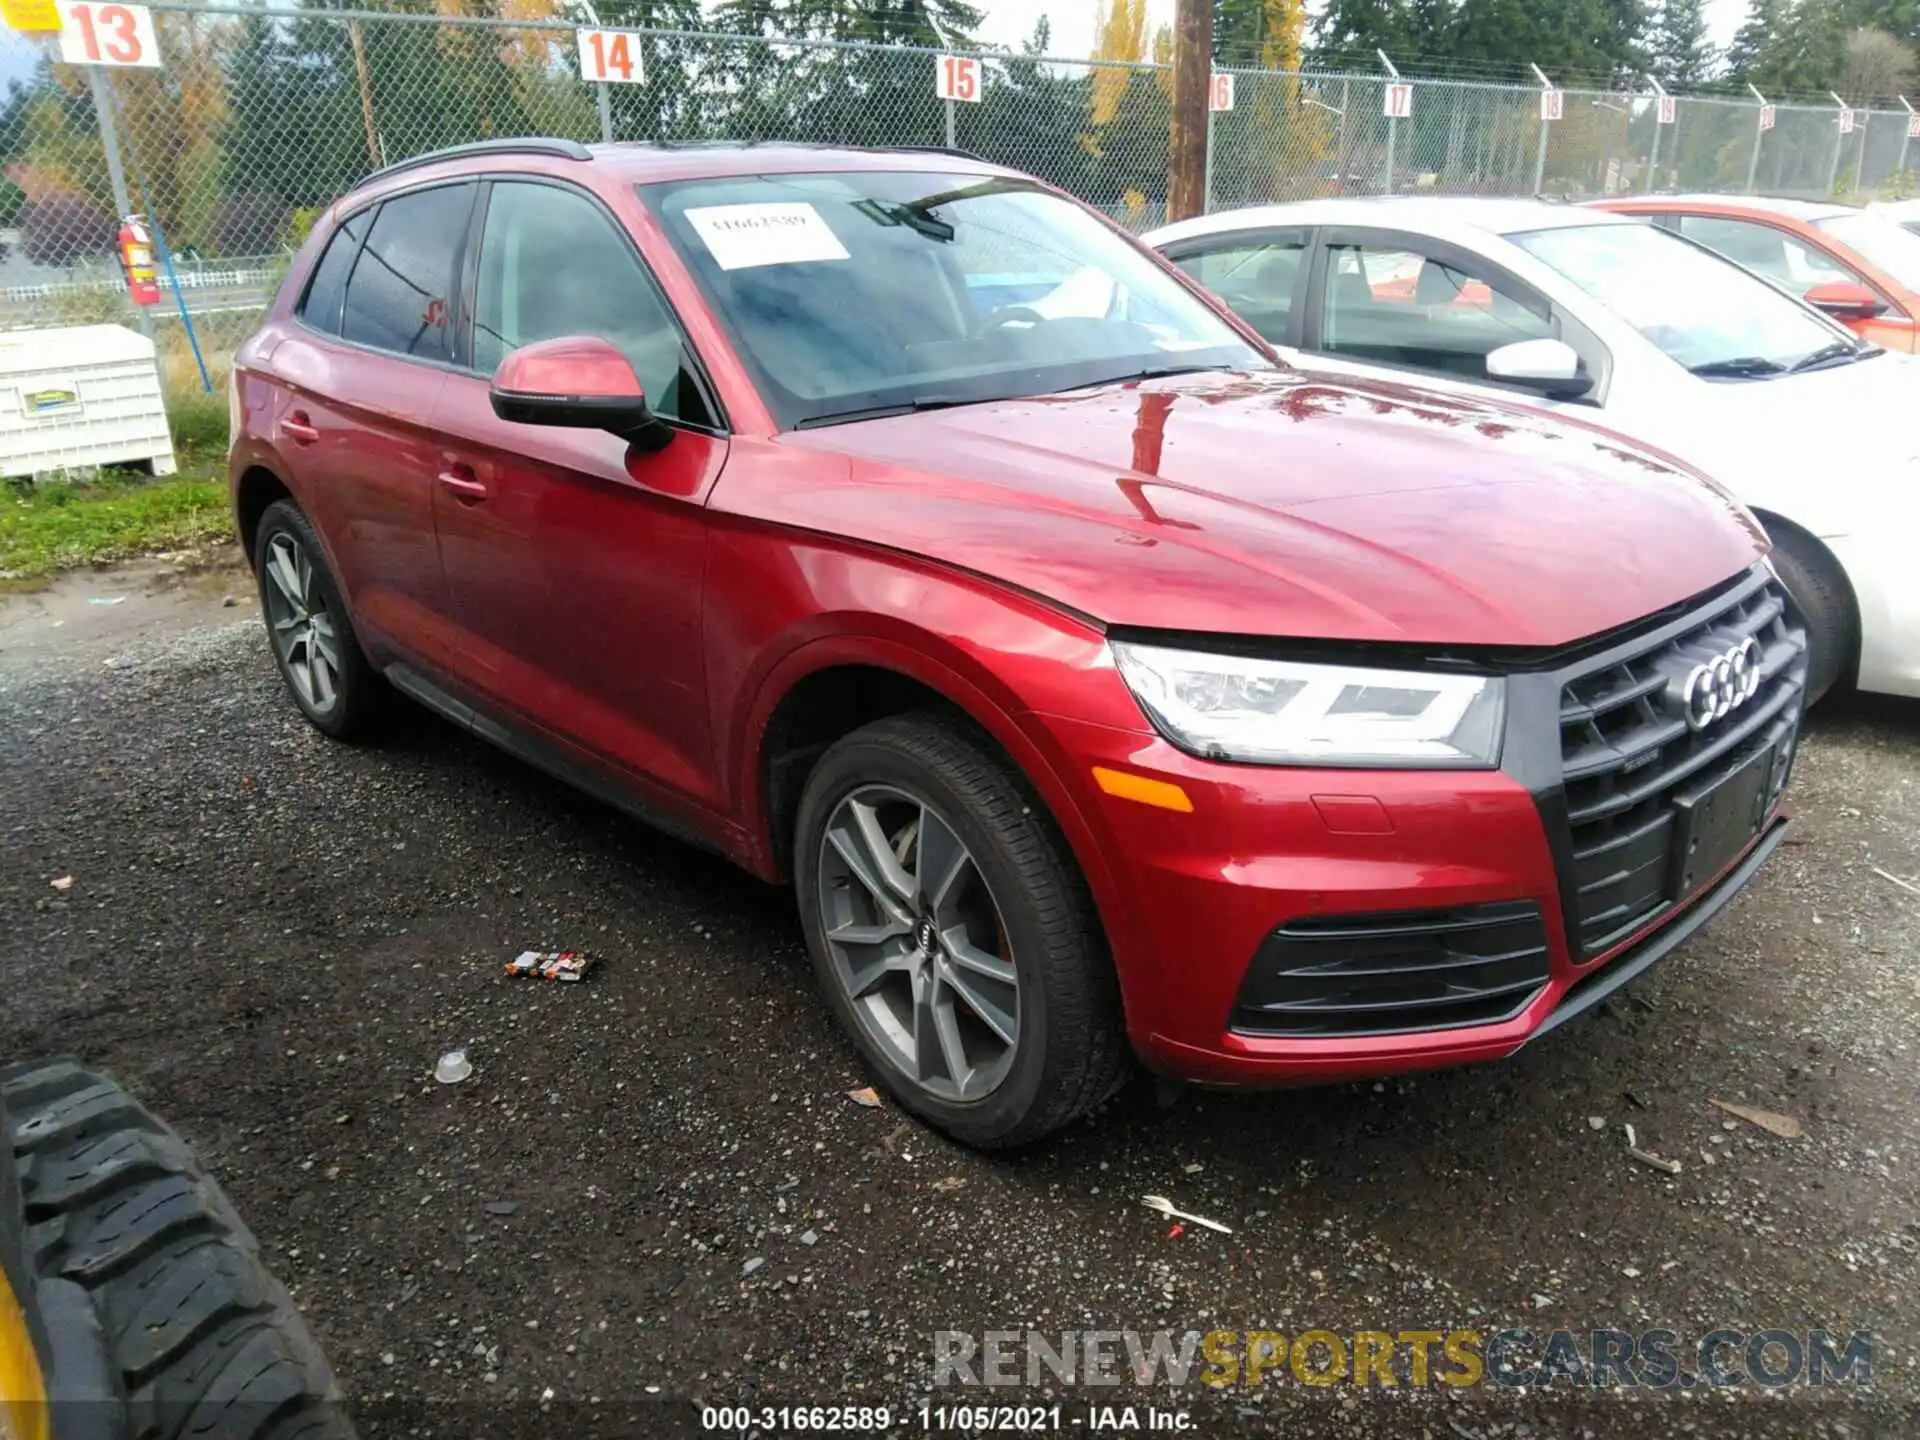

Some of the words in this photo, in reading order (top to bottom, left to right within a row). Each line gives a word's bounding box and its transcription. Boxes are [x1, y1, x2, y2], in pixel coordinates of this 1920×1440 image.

[70, 4, 141, 62] 13
[589, 32, 633, 79] 14
[944, 58, 974, 99] 15
[1391, 86, 1408, 115] 17
[1547, 92, 1559, 117] 18
